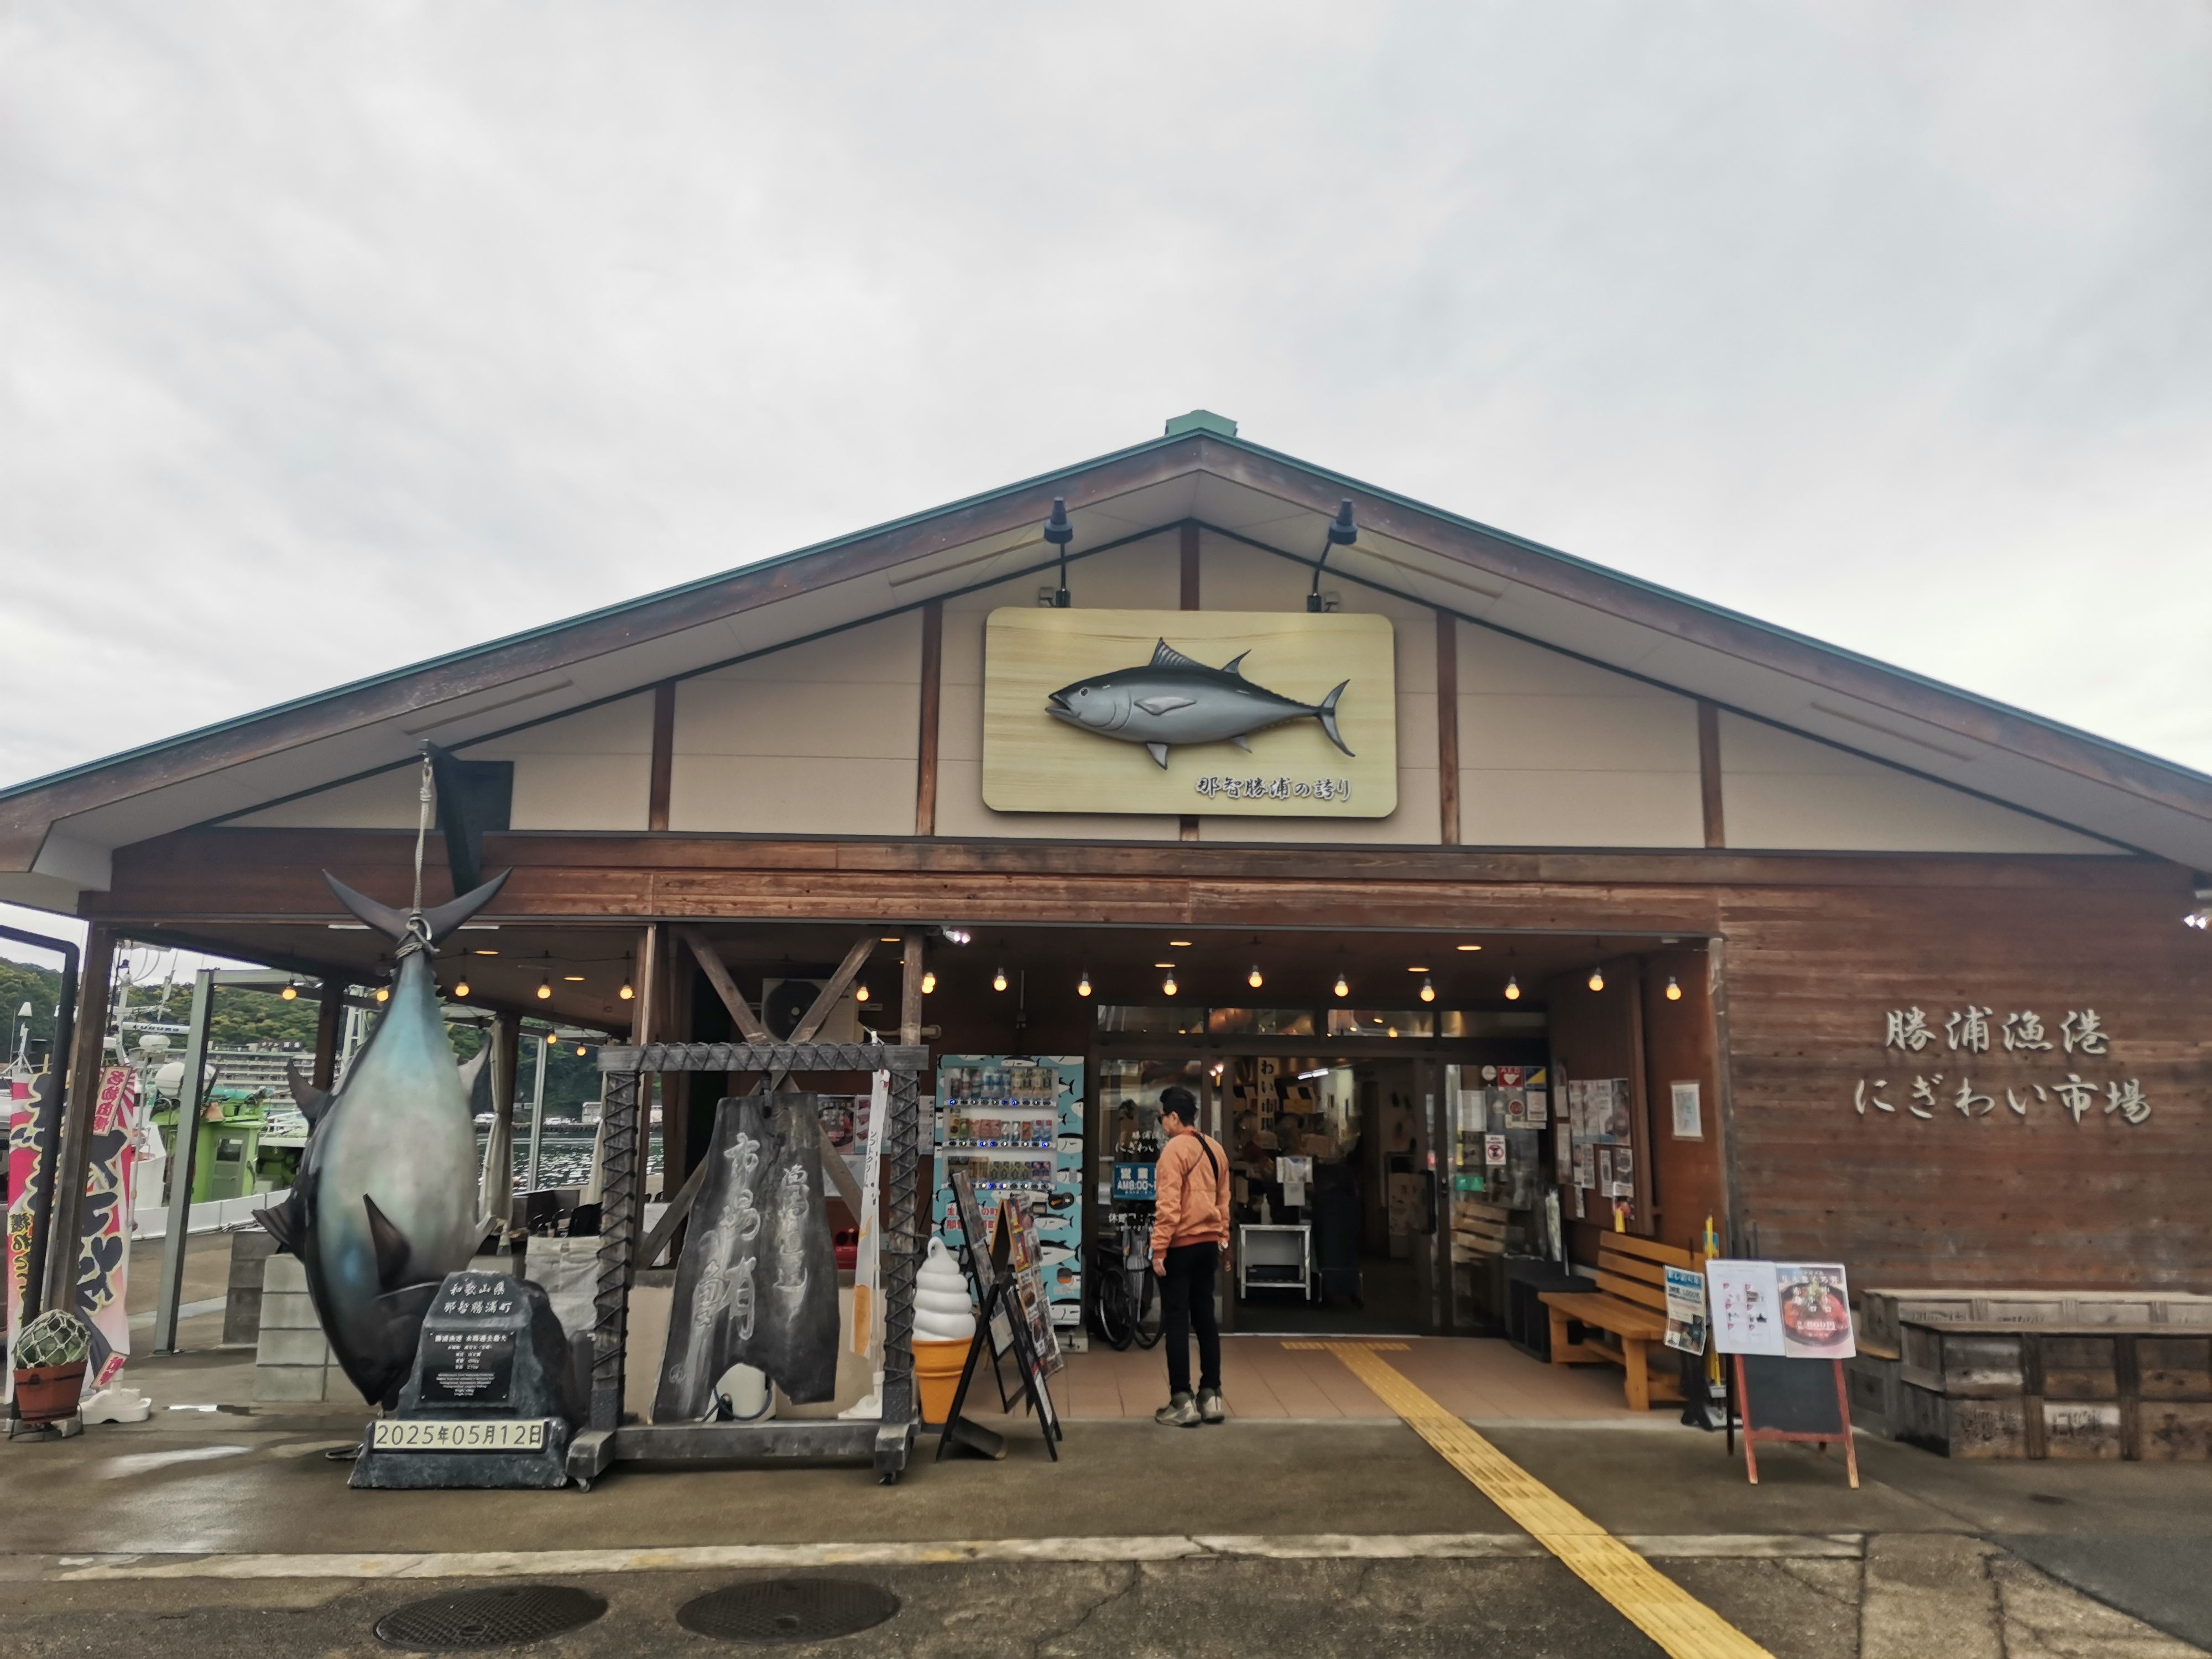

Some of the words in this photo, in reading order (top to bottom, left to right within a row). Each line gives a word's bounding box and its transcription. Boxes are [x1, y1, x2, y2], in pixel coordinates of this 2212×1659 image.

[1197, 776, 1351, 801] 那智勝浦の誇り
[1886, 1005, 2110, 1054] 勝浦漁港
[1854, 1072, 2152, 1125] にぎわい市場
[444, 1300, 513, 1314] 那智勝浦町
[375, 1424, 542, 1446] 2025年05月12日
